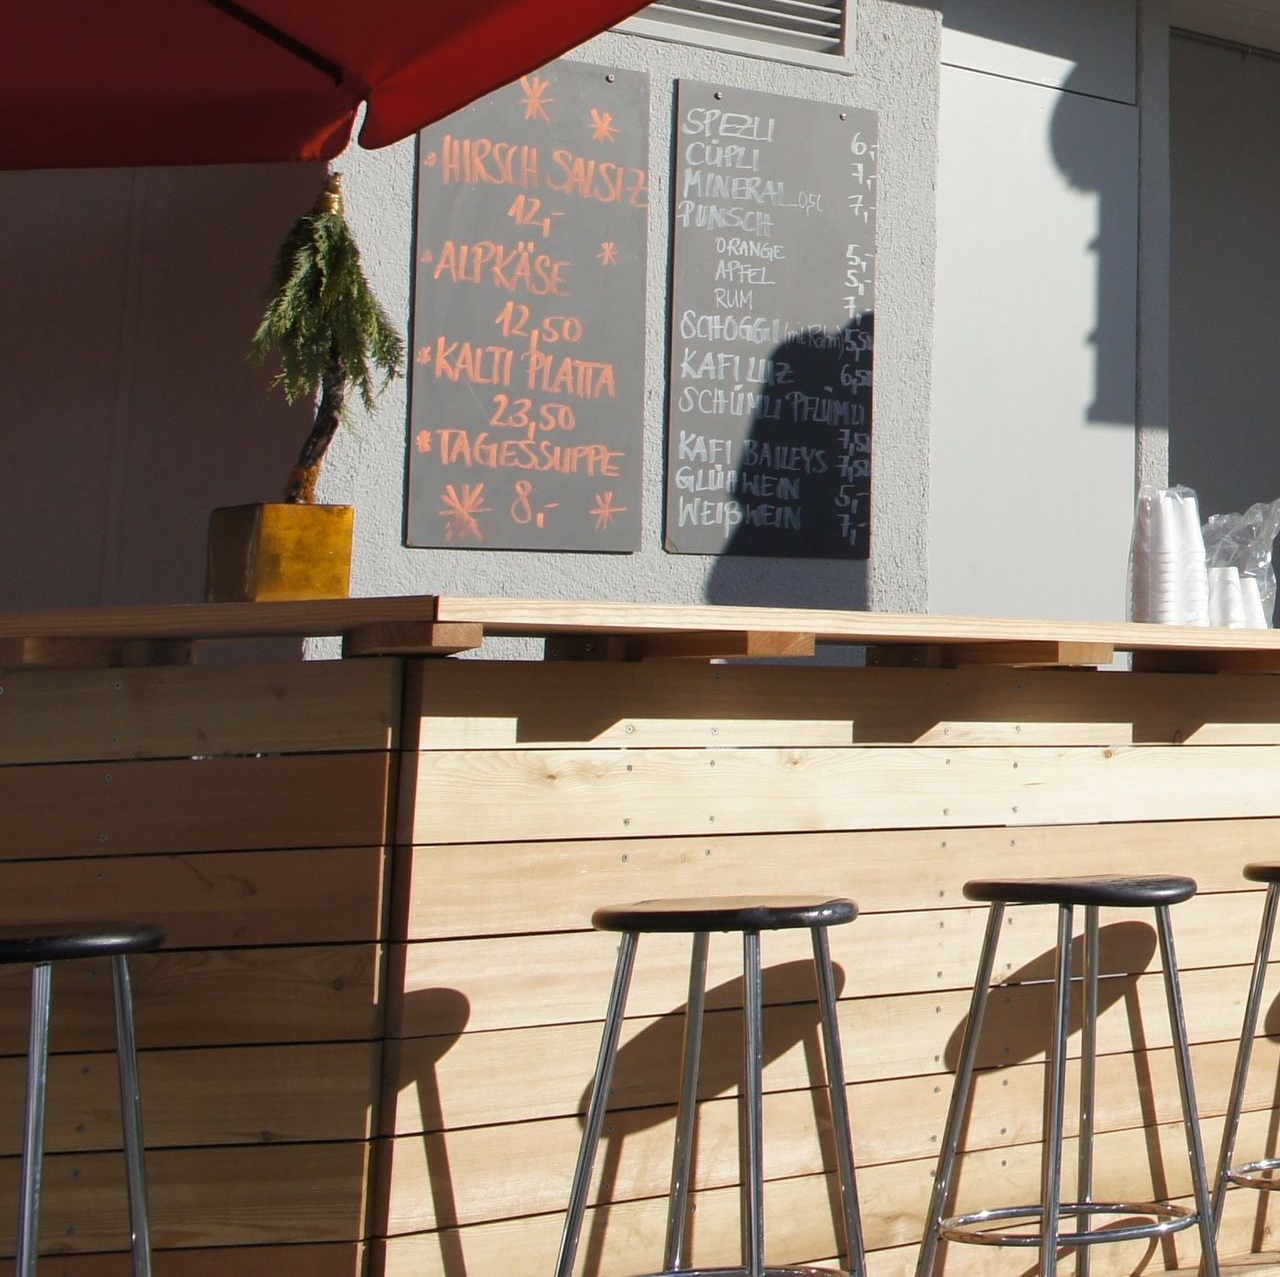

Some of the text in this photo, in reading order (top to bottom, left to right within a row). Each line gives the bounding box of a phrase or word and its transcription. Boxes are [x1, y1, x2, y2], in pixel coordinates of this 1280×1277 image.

[681, 107, 775, 142] SPEZLI
[443, 134, 649, 208] HIRSCH SALSIZ
[685, 139, 759, 172] CÜPLI
[683, 168, 798, 207] MINERAL
[676, 200, 774, 237] PUNSCH
[715, 237, 786, 261] ORANGE
[433, 241, 570, 296] ALPKÄSE
[715, 259, 775, 284] APFEL
[714, 288, 752, 310] RUM
[495, 300, 584, 352] 12,50
[680, 310, 779, 344] SCHOGGI
[435, 336, 617, 399] KALTI PLATTA
[680, 347, 740, 380] KAFI
[489, 394, 576, 440] 23,50
[434, 429, 626, 477] TAGESSUPPE
[678, 429, 732, 464] KAFI
[743, 439, 828, 474] BAILEYS
